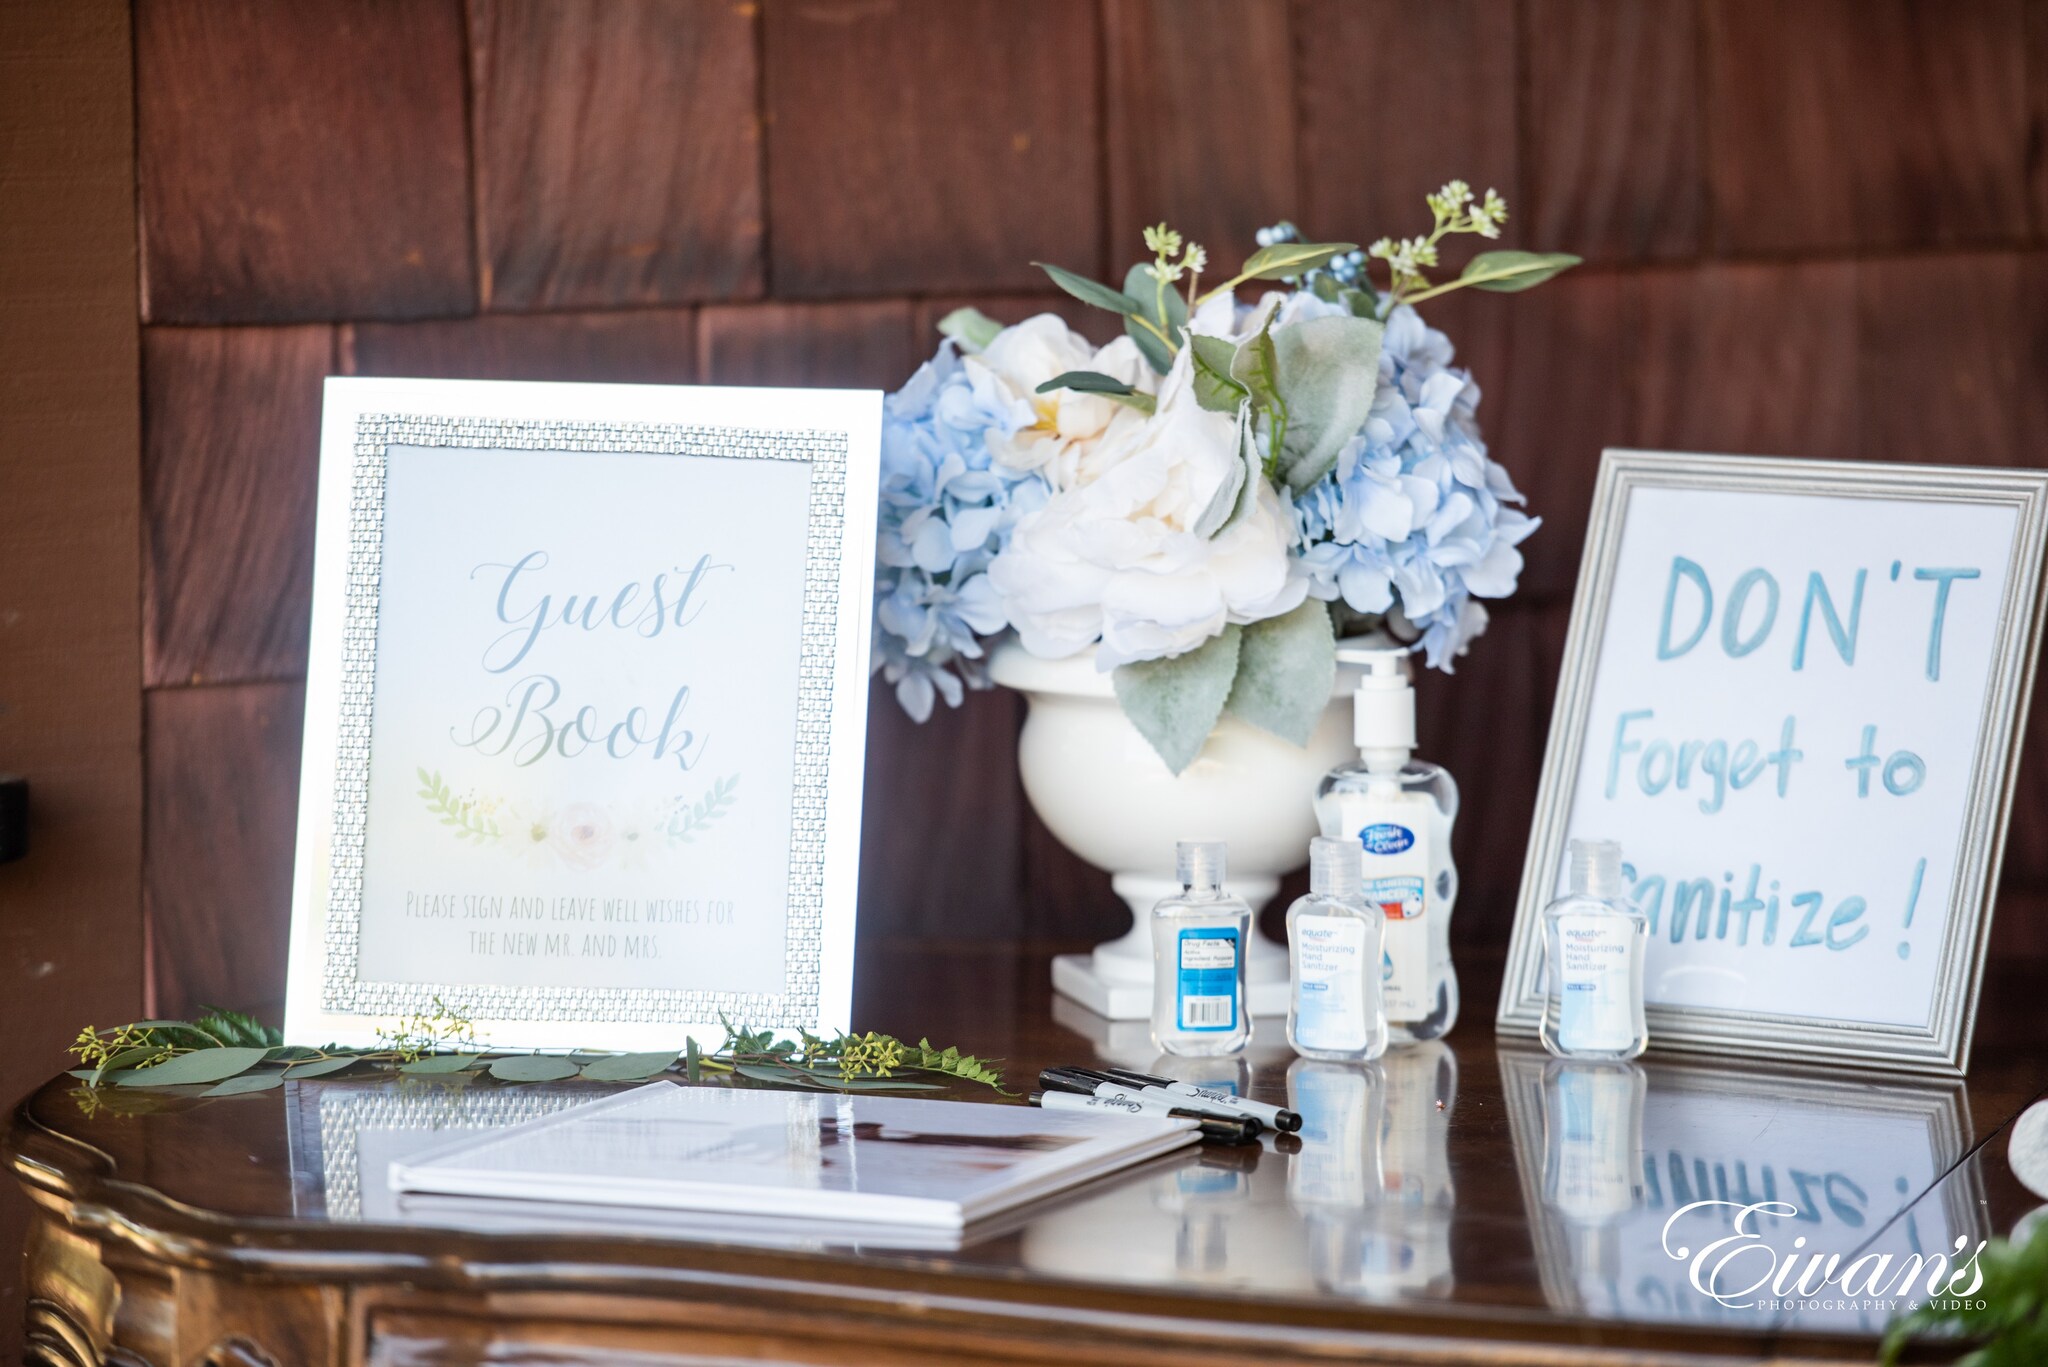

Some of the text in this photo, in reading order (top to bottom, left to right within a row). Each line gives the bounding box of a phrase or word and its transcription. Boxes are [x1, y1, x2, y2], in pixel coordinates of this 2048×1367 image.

[470, 551, 735, 674] Guest
[1656, 555, 1981, 682] DON'T
[450, 674, 709, 771] Book
[1605, 709, 1927, 814] Forget to
[406, 891, 735, 925] PLEASE SIGN AND LEAVE WELL WISHES FOR
[1301, 929, 1334, 939] equate
[468, 931, 662, 960] THE NEW MR. AND MRS.
[1301, 943, 1356, 955] Moisturizing
[1566, 944, 1625, 953] Moisturizing
[1302, 953, 1323, 962] Hand
[1566, 953, 1590, 961] Hand
[1302, 961, 1339, 972] Sanitizer
[1566, 962, 1607, 971] Sanitizer
